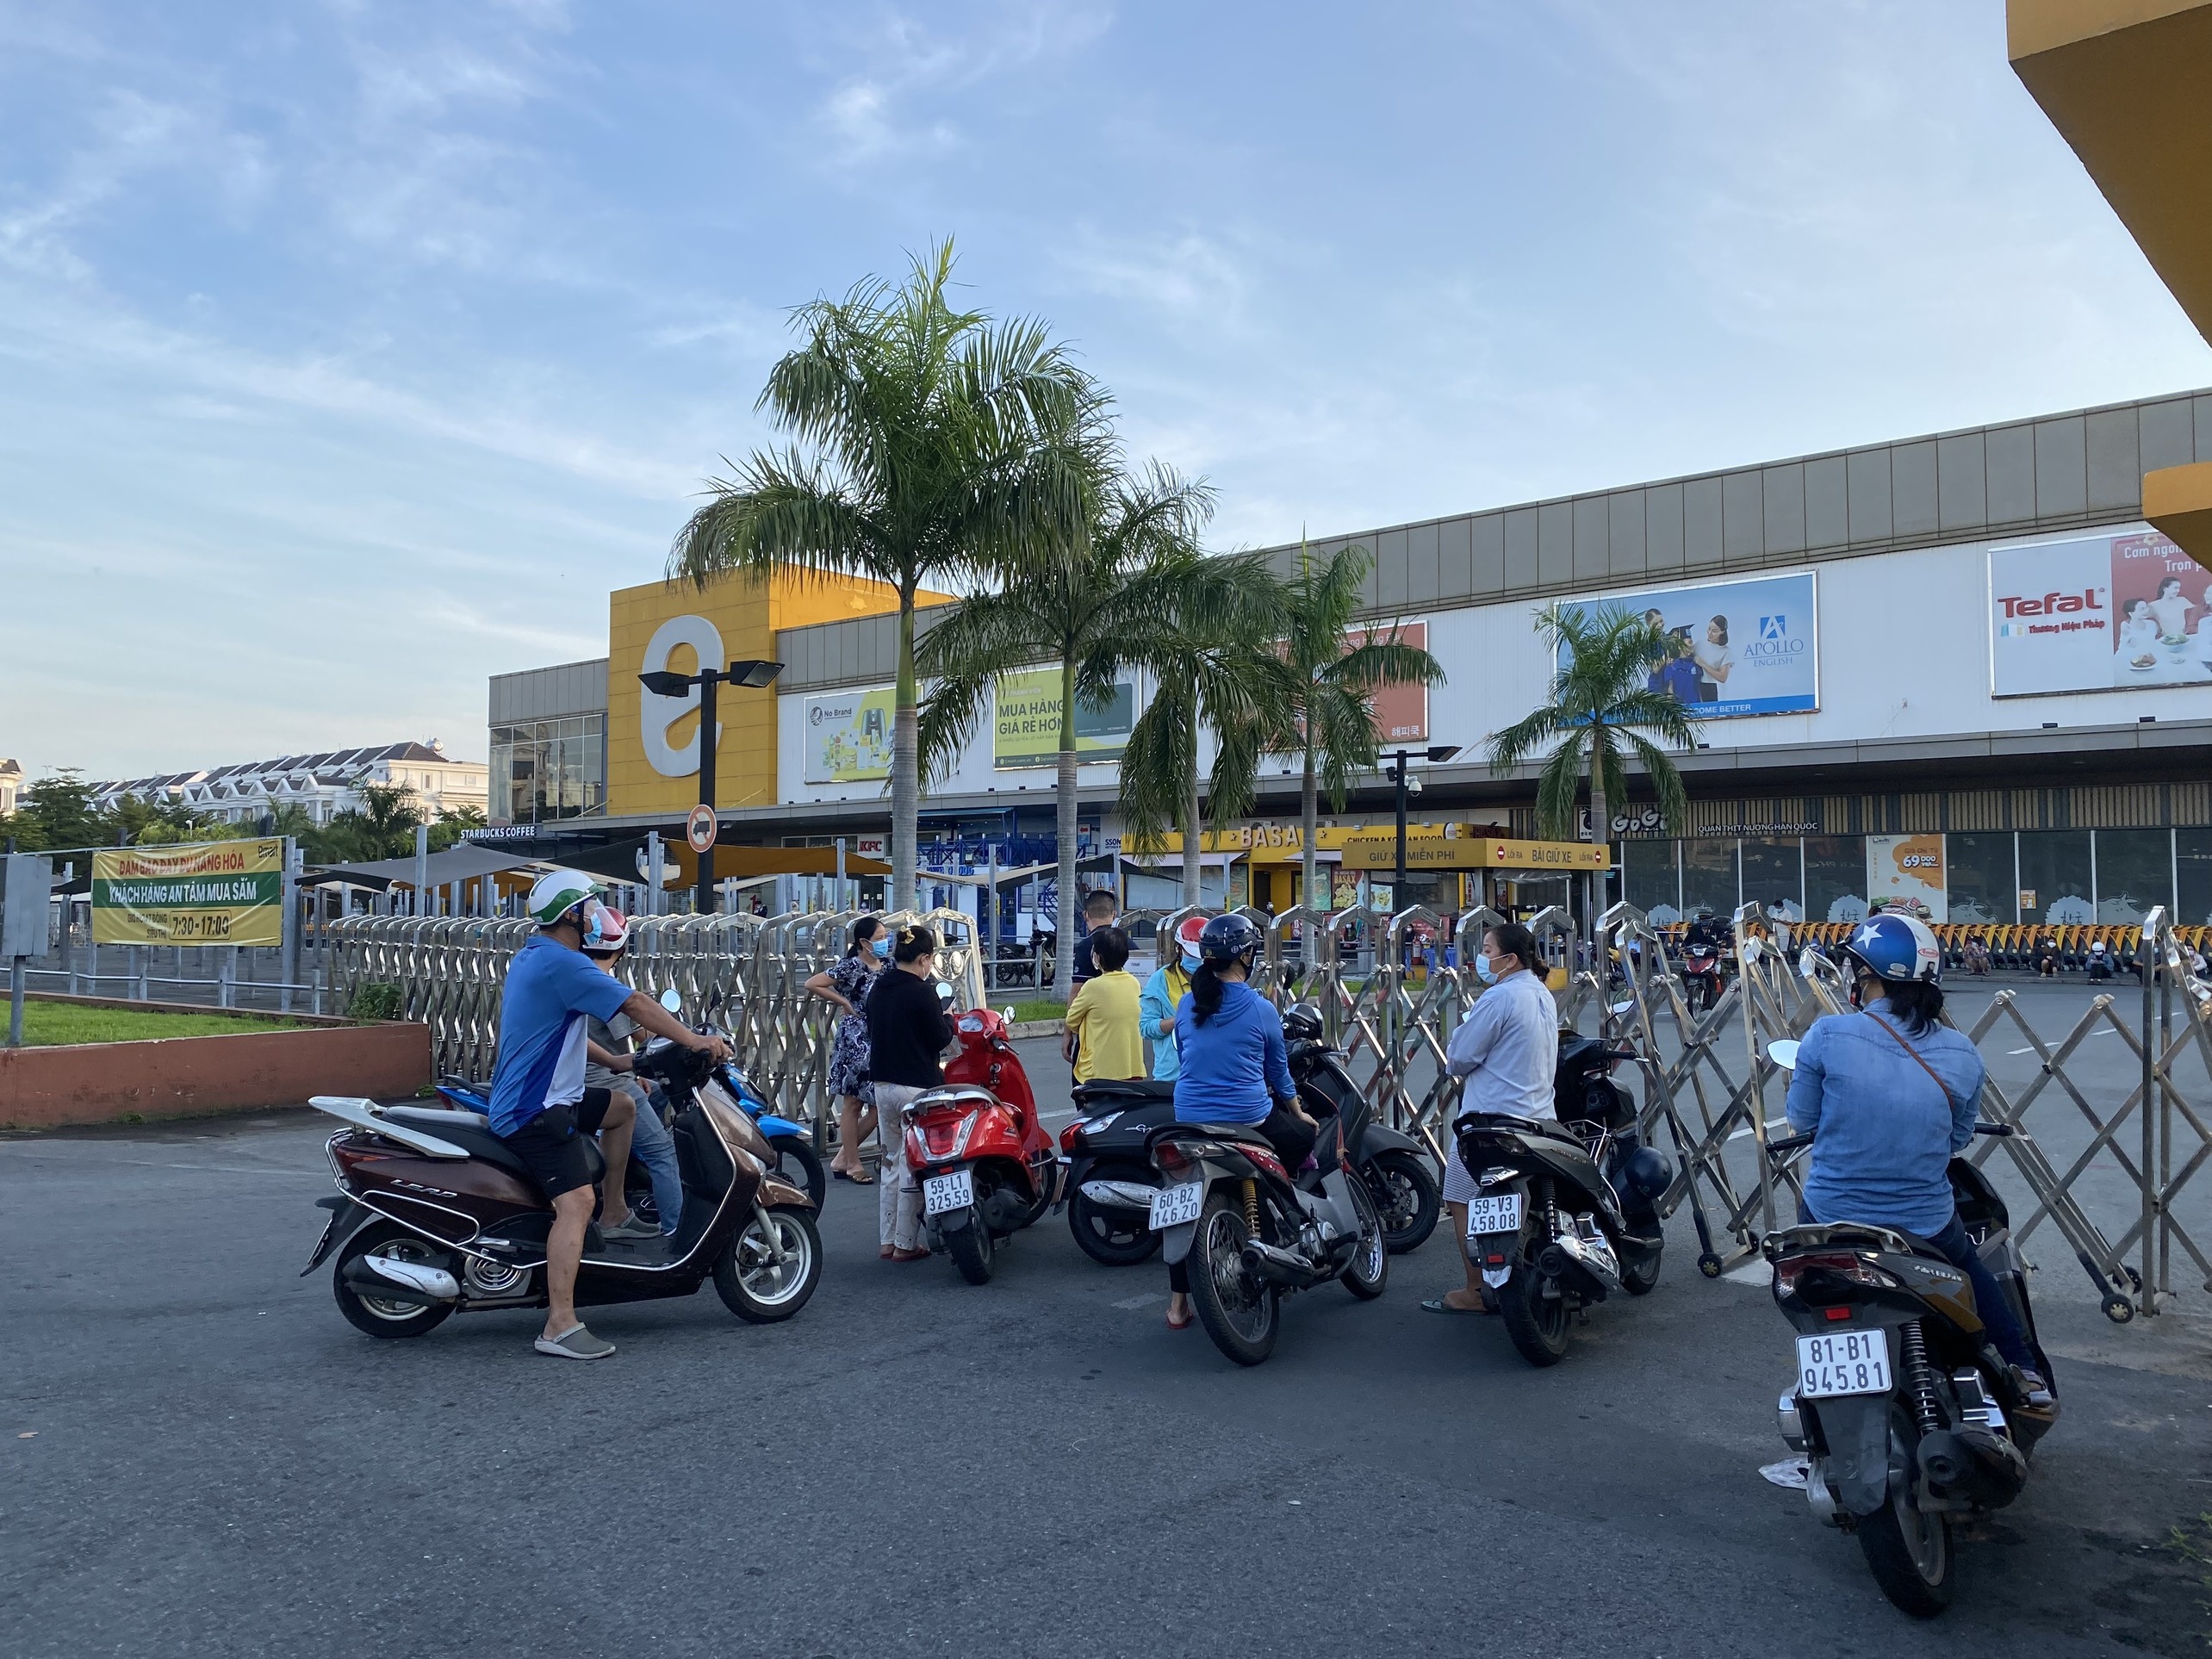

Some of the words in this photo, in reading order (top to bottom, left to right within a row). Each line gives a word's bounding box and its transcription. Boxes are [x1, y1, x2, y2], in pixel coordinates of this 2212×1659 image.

[2124, 546, 2150, 559] Cơm
[2165, 559, 2192, 573] Trọn
[1998, 588, 2103, 618] Tefal
[1743, 638, 1804, 658] APOLLO
[1753, 656, 1793, 668] ENGLISH
[834, 707, 852, 717] Brand
[999, 702, 1027, 718] MUA
[1029, 698, 1063, 716] HÀNG
[1719, 704, 1751, 713] BETTER
[999, 718, 1020, 735] GIÁ
[1022, 716, 1036, 733] RẺ
[460, 827, 505, 839] STARBUCKS
[506, 826, 535, 837] COFFEE
[1240, 824, 1300, 848] BASA
[858, 840, 883, 852] KFC
[1369, 849, 1388, 861] GIỮ
[1407, 848, 1434, 861] MIỄN
[1437, 848, 1455, 861] PHÍ
[1532, 847, 1544, 862] BÃI
[1546, 848, 1561, 863] GIỮ
[1562, 850, 1572, 863] XE
[194, 852, 221, 873] HÀNG
[222, 849, 245, 871] HÓA
[1903, 854, 1920, 868] 69
[109, 882, 140, 904] KHÁCH
[140, 882, 167, 904] HÀNG
[168, 885, 183, 903] AN
[183, 880, 206, 903] TÂM
[207, 882, 231, 902] MUA
[232, 877, 257, 901] SẮM
[390, 1178, 457, 1198] LEAD
[930, 1175, 962, 1195] 59-L1
[929, 1189, 970, 1211] 325.59
[1159, 1187, 1194, 1209] 60-B2
[1475, 1196, 1513, 1215] 59-V3
[1154, 1202, 1198, 1227] 146.20
[1470, 1213, 1516, 1233] 458.08
[1811, 1334, 1871, 1364] 81-B1
[1805, 1361, 1884, 1393] 945.81
